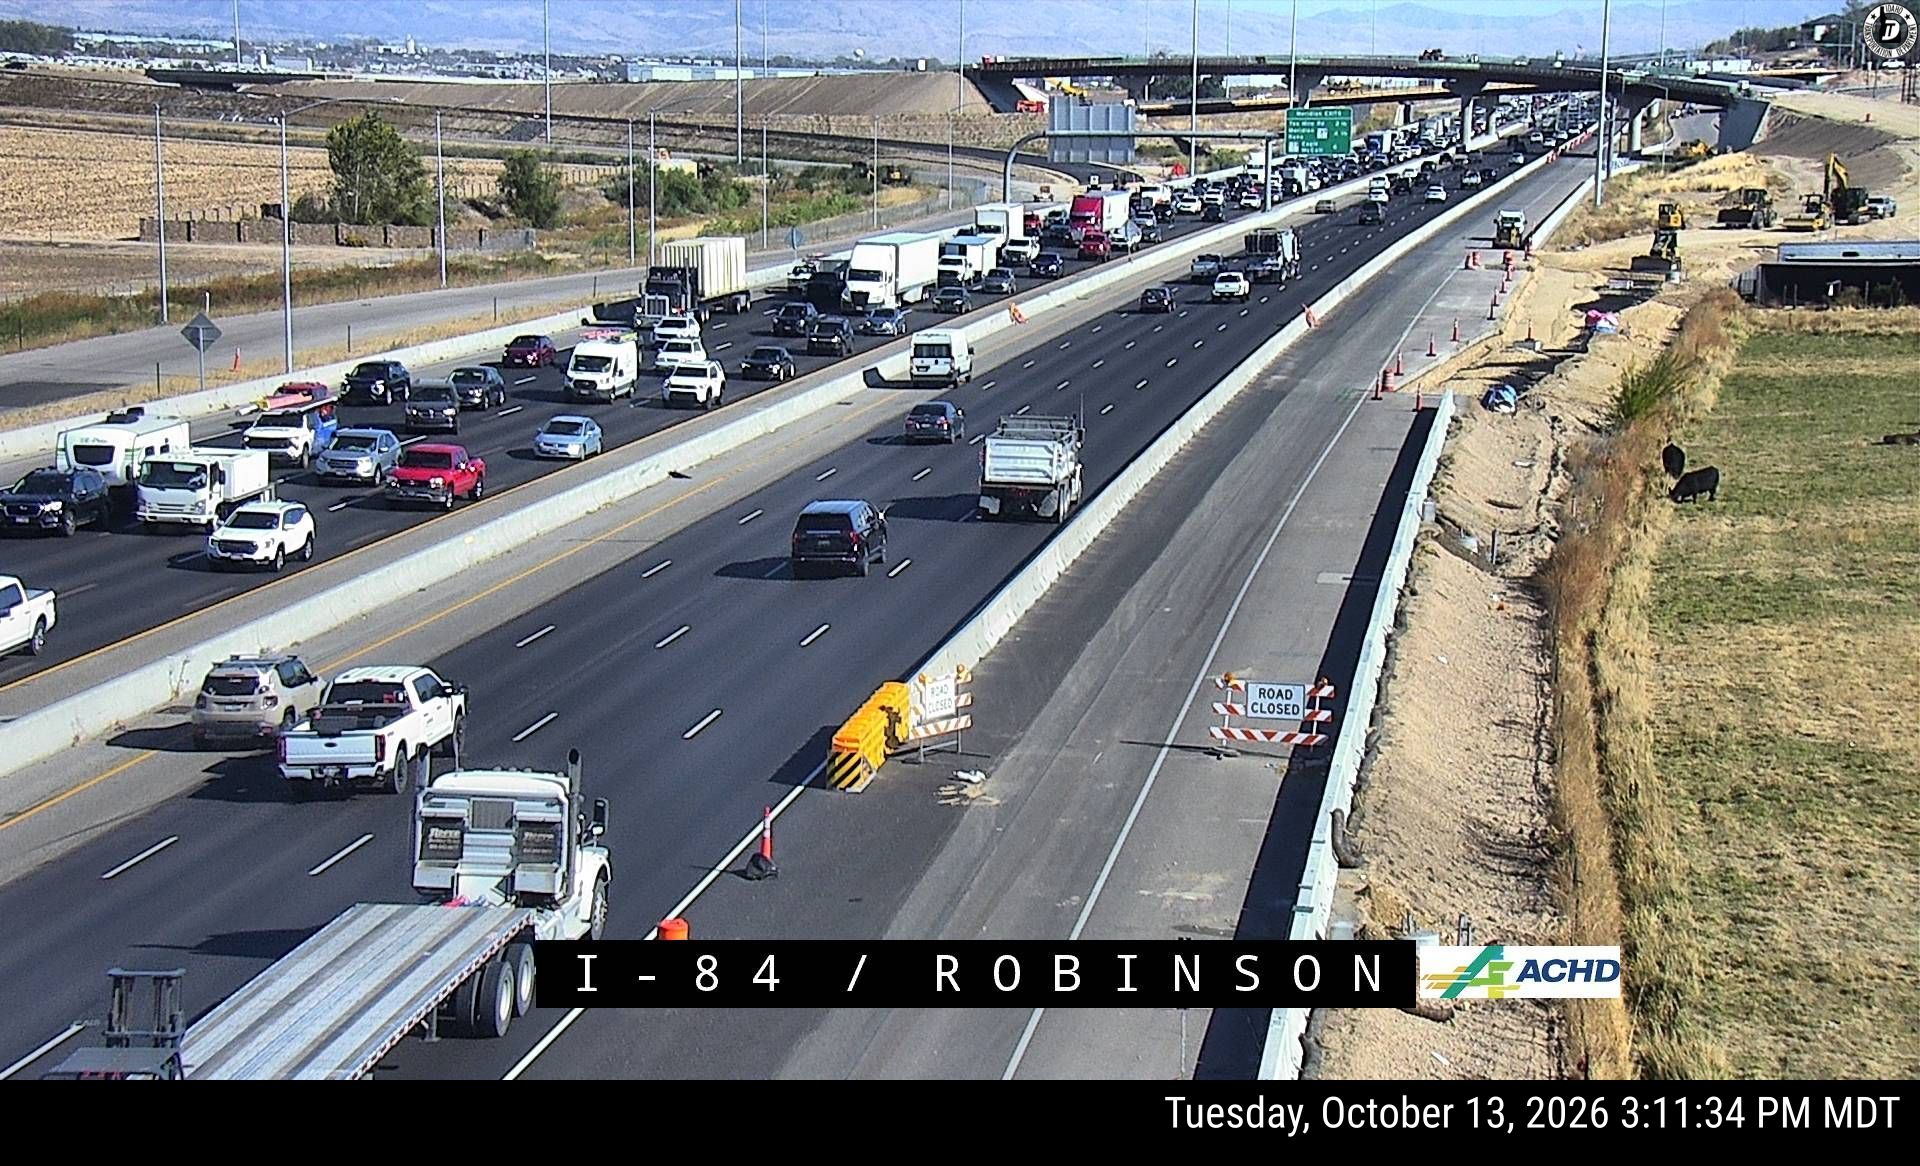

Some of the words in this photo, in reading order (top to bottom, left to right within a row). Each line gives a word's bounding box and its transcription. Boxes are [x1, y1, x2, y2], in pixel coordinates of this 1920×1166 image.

[930, 684, 949, 698] ROAD
[1258, 687, 1293, 701] ROAD
[927, 698, 953, 714] CLOSED
[1250, 701, 1300, 715] CLOSED
